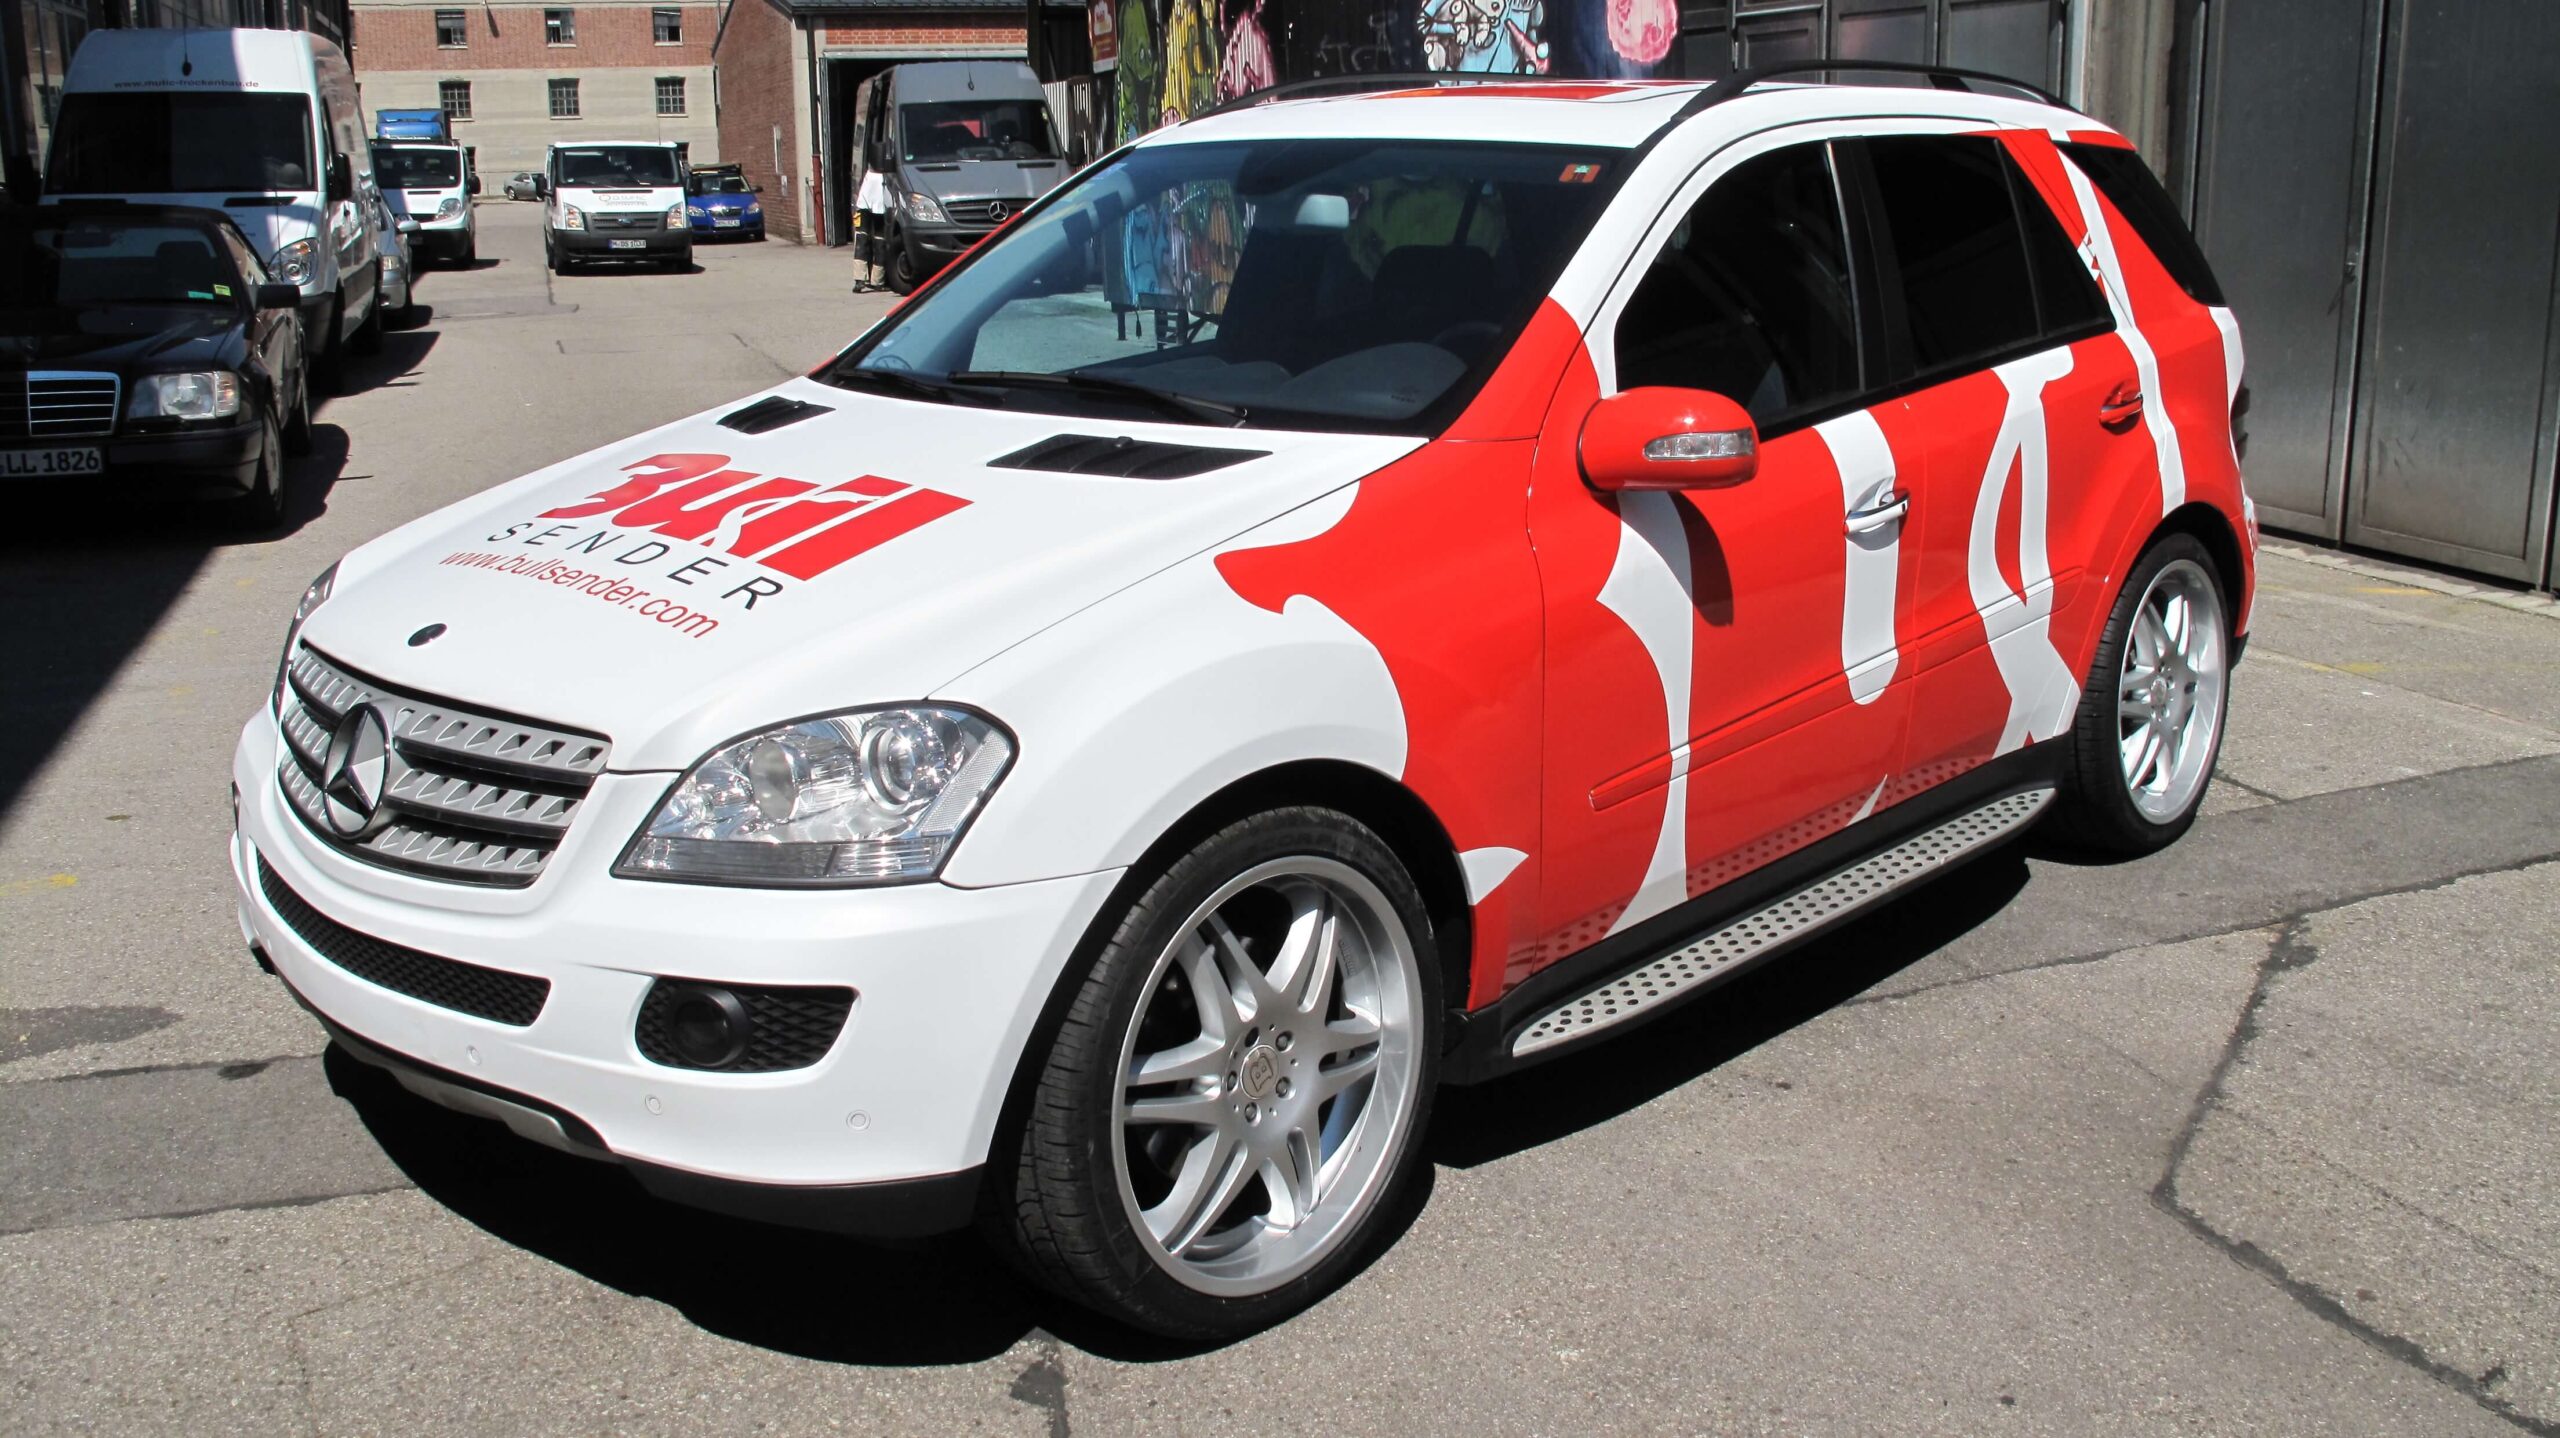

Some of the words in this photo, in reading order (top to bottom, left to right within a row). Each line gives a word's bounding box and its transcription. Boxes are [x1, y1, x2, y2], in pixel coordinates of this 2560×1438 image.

[43, 450, 99, 472] 1826
[439, 552, 719, 638] www.bullsender.com
[487, 522, 784, 610] SENDER
